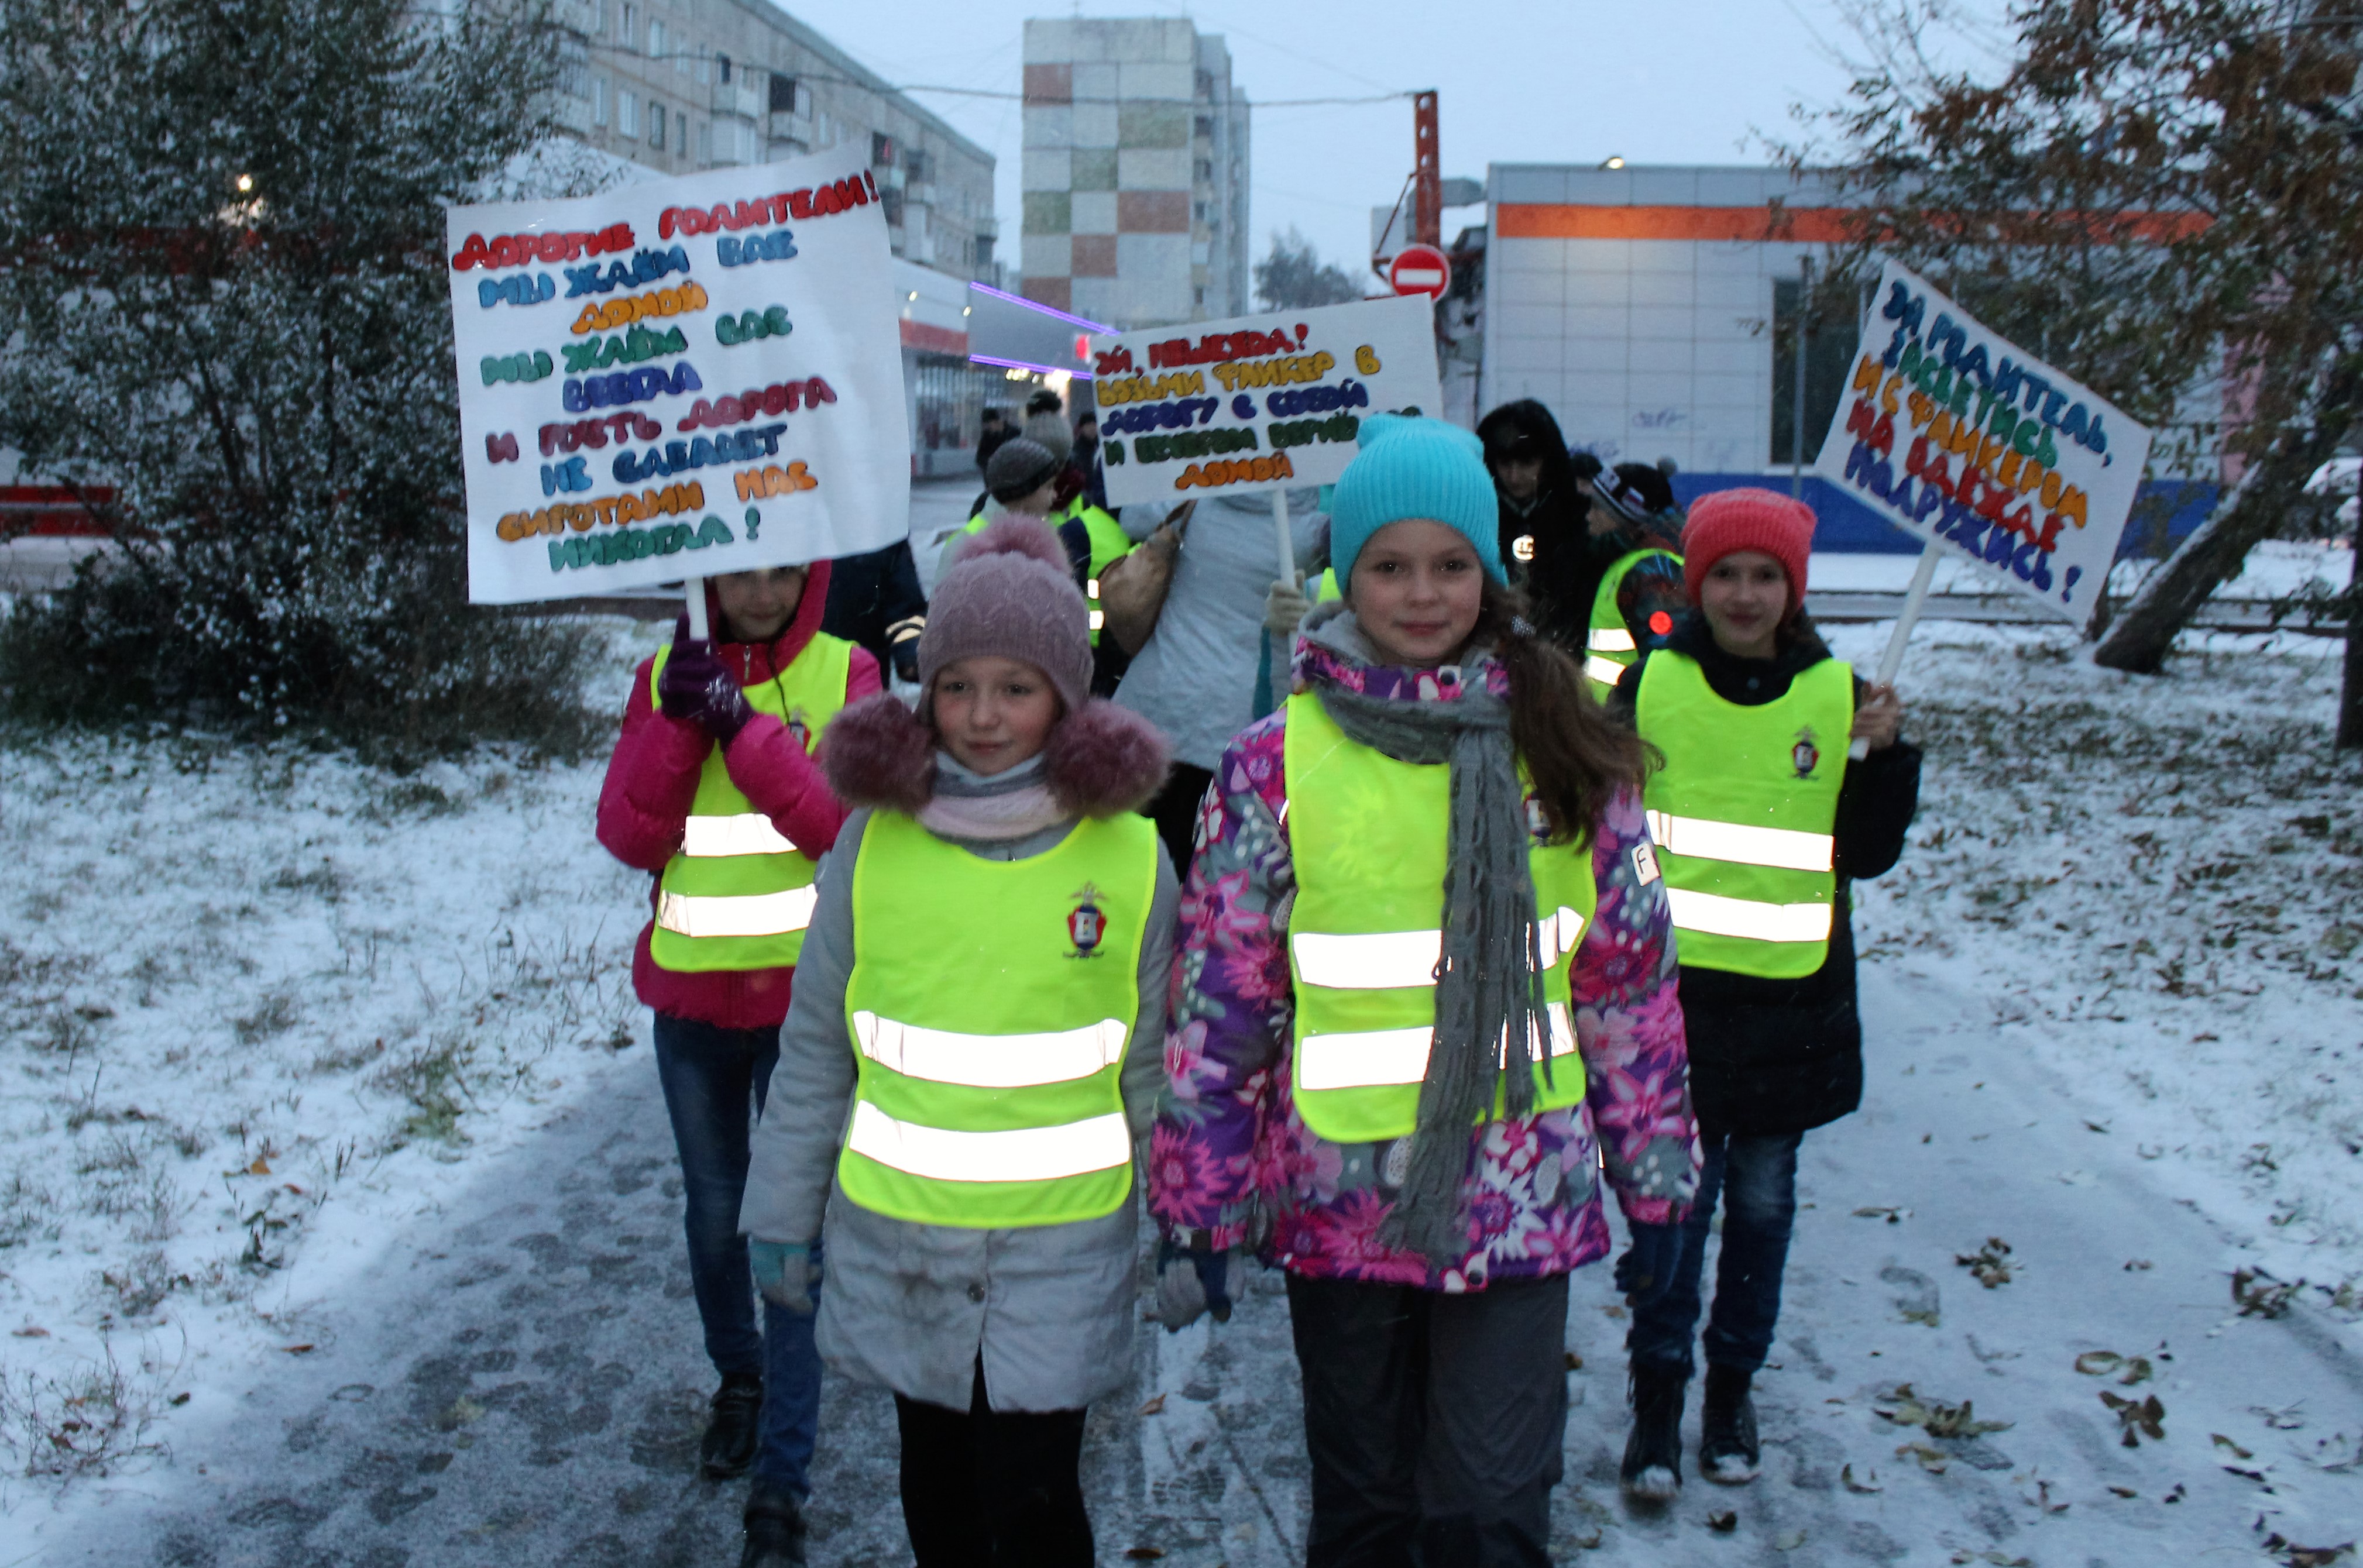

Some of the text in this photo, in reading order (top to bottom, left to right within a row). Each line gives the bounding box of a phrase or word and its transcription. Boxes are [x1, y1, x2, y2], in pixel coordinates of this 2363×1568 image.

[452, 169, 879, 271] ДОРОГИЕ РОДИТЕЛИ!
[478, 229, 798, 308] МЫ ЖДЁМ ВАС
[571, 279, 708, 334] ДОМОЙ
[480, 304, 792, 386] МЫ ЖДЁМ ВАС
[1096, 345, 1381, 407] ВОЗЬМИ ФЛИКЕР В
[485, 375, 837, 463] И ПУСТЬ ДОРОГА
[562, 361, 703, 412] ВСЕГДА
[1101, 378, 1368, 436] ДОРОГУ С СОБОЙ
[541, 423, 787, 497] НЕ СДЕЛАЕТ
[1103, 441, 1125, 466] И
[1175, 450, 1294, 490] ДОМОЙ
[1846, 398, 2065, 553] НА ОДЕЖДЕ
[1853, 353, 2088, 529] И С ФЛИКЕРОМ
[496, 460, 818, 542] СИРОТАМИ НАС
